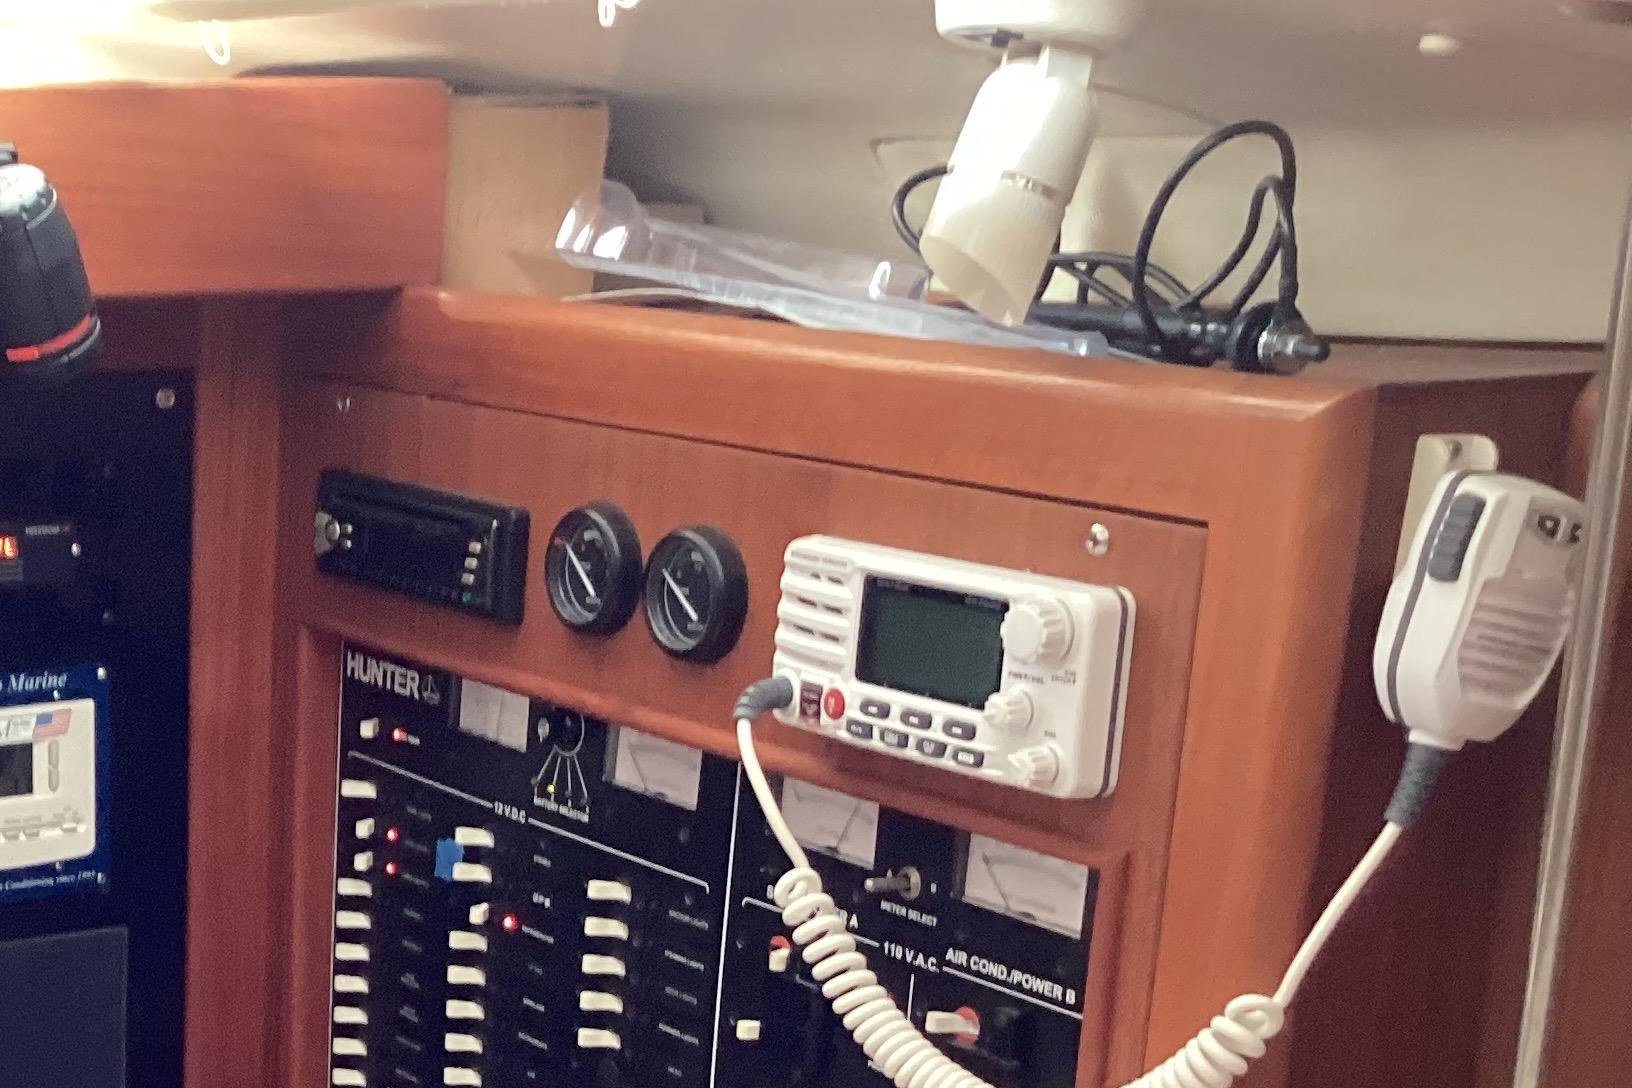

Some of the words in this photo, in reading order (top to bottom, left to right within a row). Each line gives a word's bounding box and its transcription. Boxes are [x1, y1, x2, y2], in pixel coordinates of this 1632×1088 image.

[9, 670, 67, 693] Marine
[348, 649, 419, 700] HUNTER
[883, 941, 903, 960] 110
[945, 948, 968, 969] AIR
[1066, 989, 1076, 1006] B
